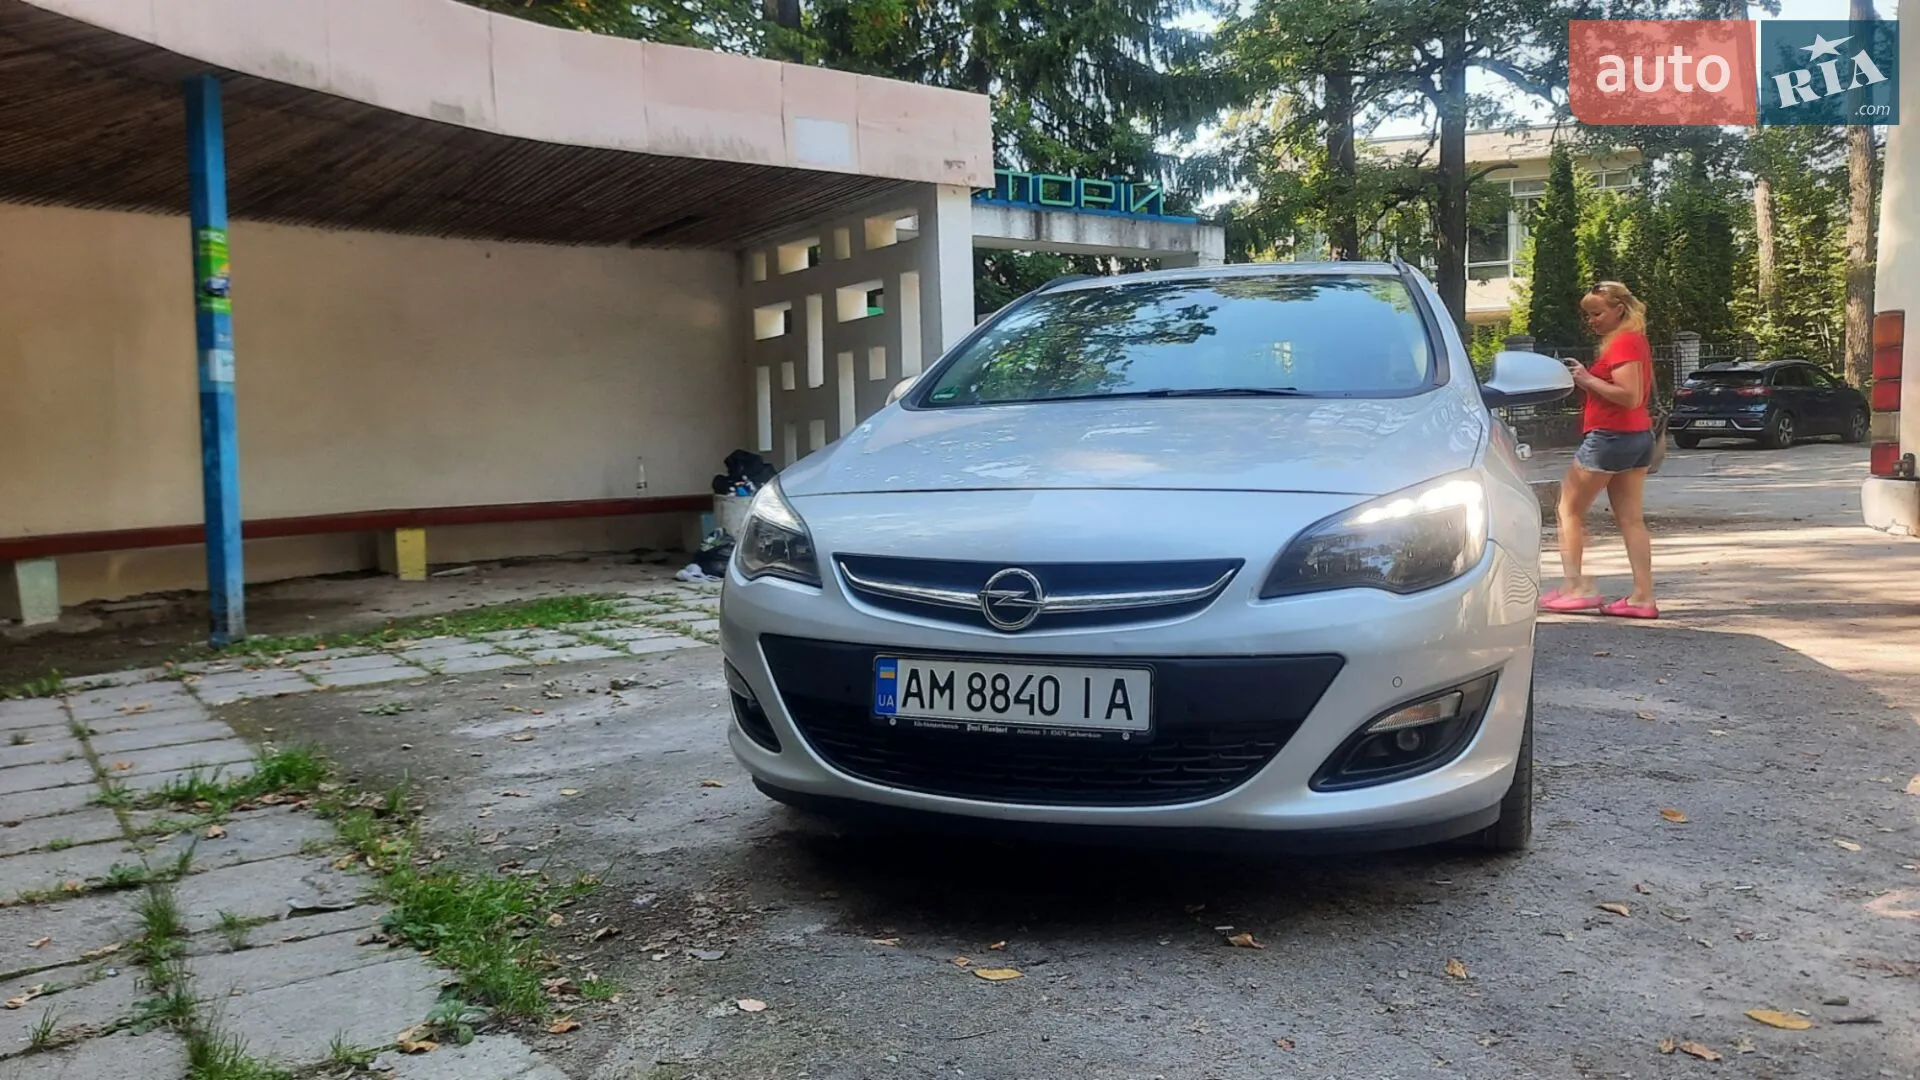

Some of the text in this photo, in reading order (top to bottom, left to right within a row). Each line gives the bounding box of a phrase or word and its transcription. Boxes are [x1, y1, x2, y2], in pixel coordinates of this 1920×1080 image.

[878, 694, 895, 708] UA
[901, 668, 955, 711] AM
[966, 671, 1061, 716] 8840
